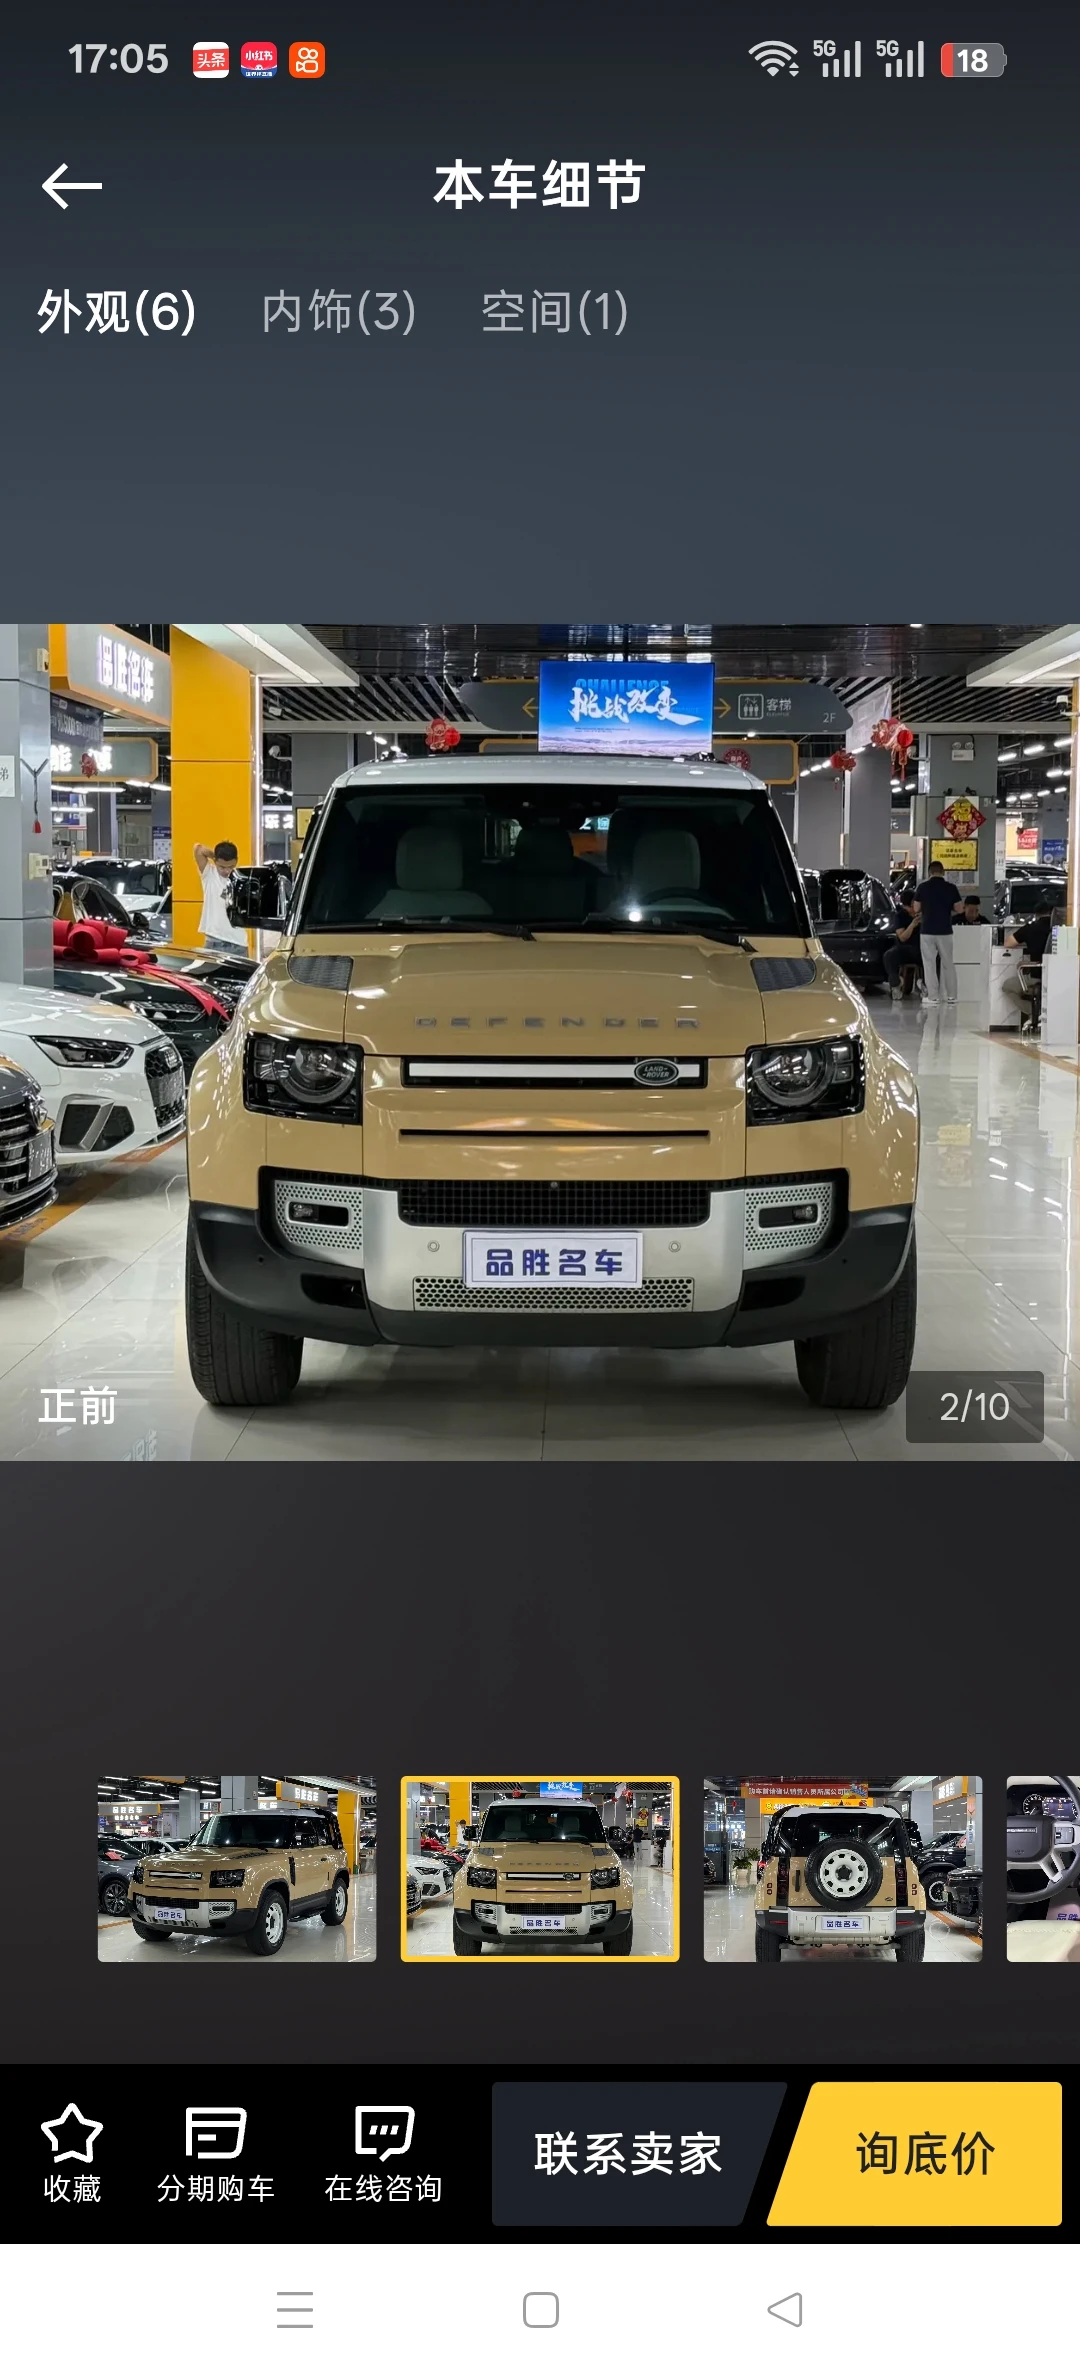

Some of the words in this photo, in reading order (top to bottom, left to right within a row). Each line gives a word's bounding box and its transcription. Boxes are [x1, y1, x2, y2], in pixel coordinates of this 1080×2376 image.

[69, 44, 168, 73] 17:05
[197, 53, 225, 68] 头条
[246, 50, 273, 60] 小红书
[813, 40, 836, 57] 5G
[876, 40, 899, 57] 5G
[957, 48, 989, 73] 18
[433, 159, 645, 209] 本车细节
[37, 288, 196, 336] 外观(6)
[262, 288, 416, 336] 内饰(3)
[481, 288, 629, 336] 空间(1)
[98, 634, 155, 704] 品胜名车
[567, 686, 705, 726] 挑战改变
[766, 698, 791, 711] 客梯
[823, 713, 836, 723] 2F
[414, 1016, 699, 1029] DEFENDER
[486, 1248, 623, 1276] 品胜名车
[535, 2131, 722, 2176] 联系卖家
[857, 2131, 995, 2176] 询底价
[44, 2175, 101, 2203] 收藏
[158, 2174, 275, 2203] 分期购车
[325, 2174, 442, 2203] 在线咨询
